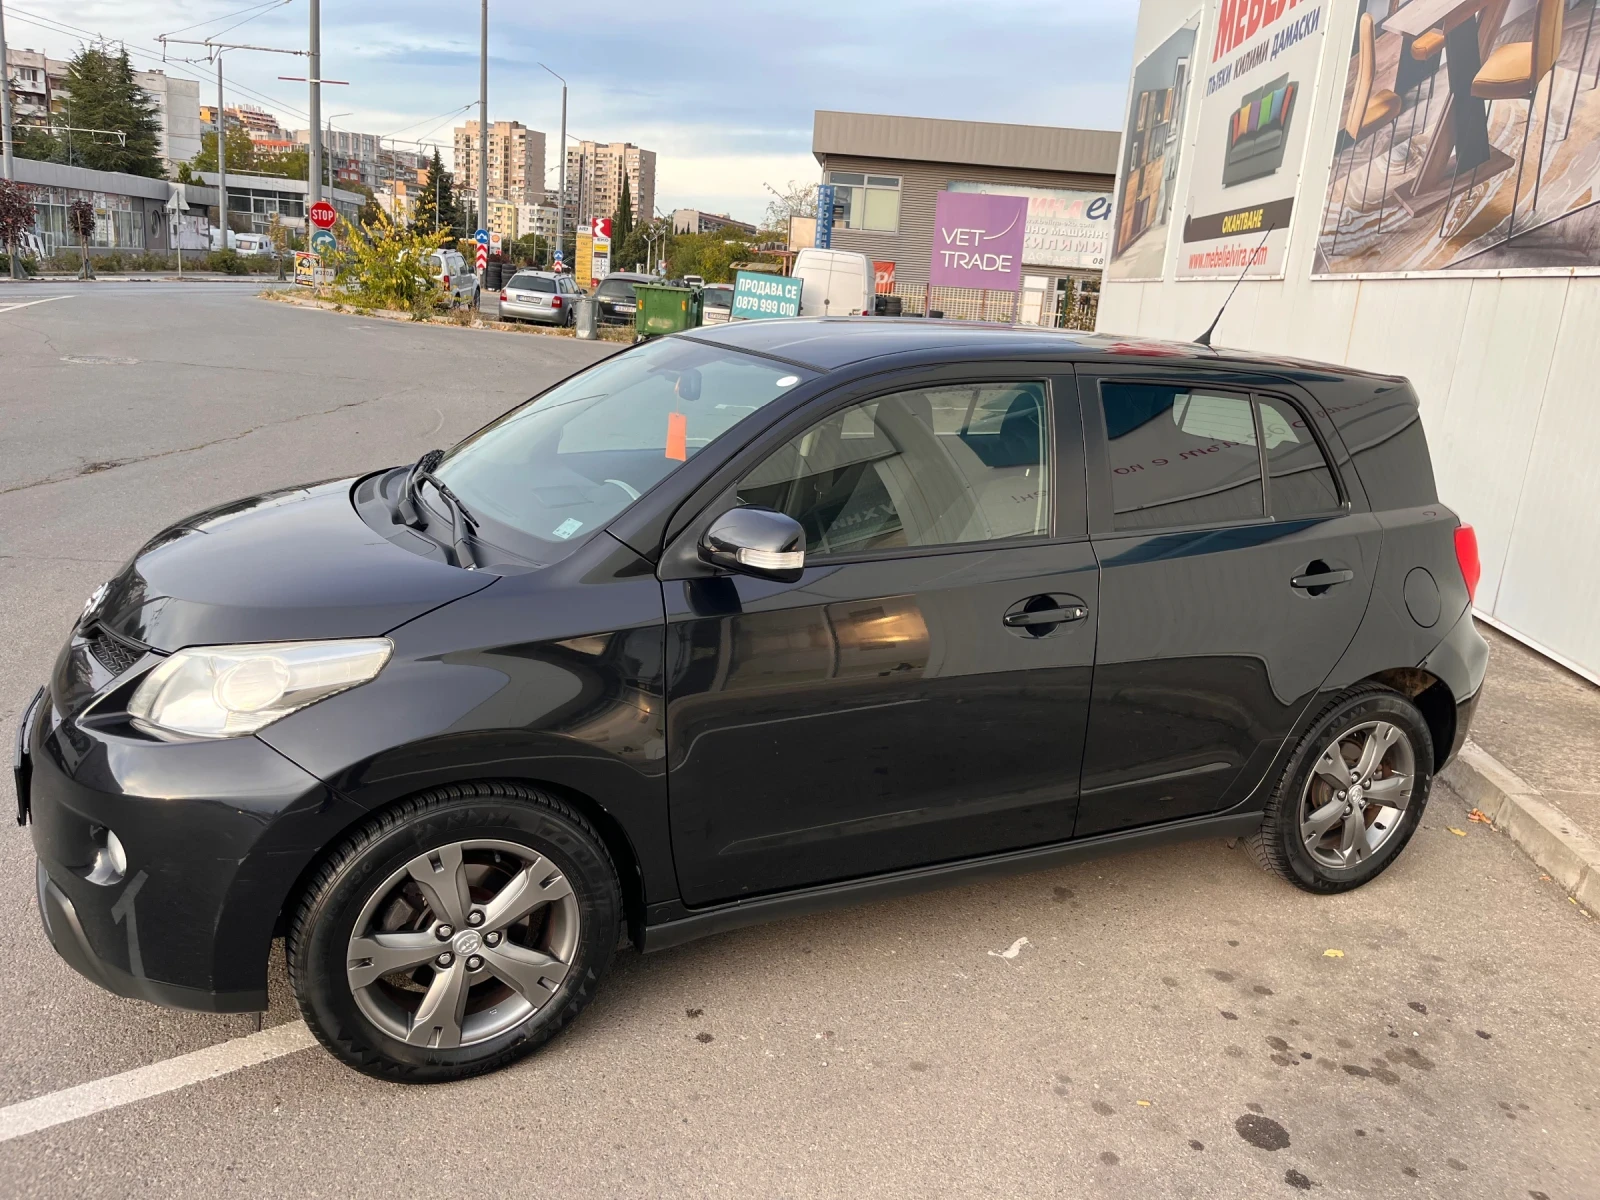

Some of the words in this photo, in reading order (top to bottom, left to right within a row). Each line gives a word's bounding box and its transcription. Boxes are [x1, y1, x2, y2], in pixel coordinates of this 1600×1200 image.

[1206, 63, 1233, 97] ПЪТЕКИ
[1233, 38, 1270, 80] КИЛИМИ
[1270, 5, 1321, 62] ДАМАСКИ
[312, 209, 334, 221] STOP
[1222, 208, 1264, 234] ОКАНТВАНЕ
[942, 227, 986, 247] VET
[940, 250, 1013, 273] TRADE
[1188, 243, 1268, 270] www.mebelielvira.com
[738, 278, 783, 297] ПРОДАВА
[785, 284, 798, 299] СЕ
[736, 295, 758, 311] 0879
[760, 299, 778, 314] 999
[780, 302, 795, 317] 010
